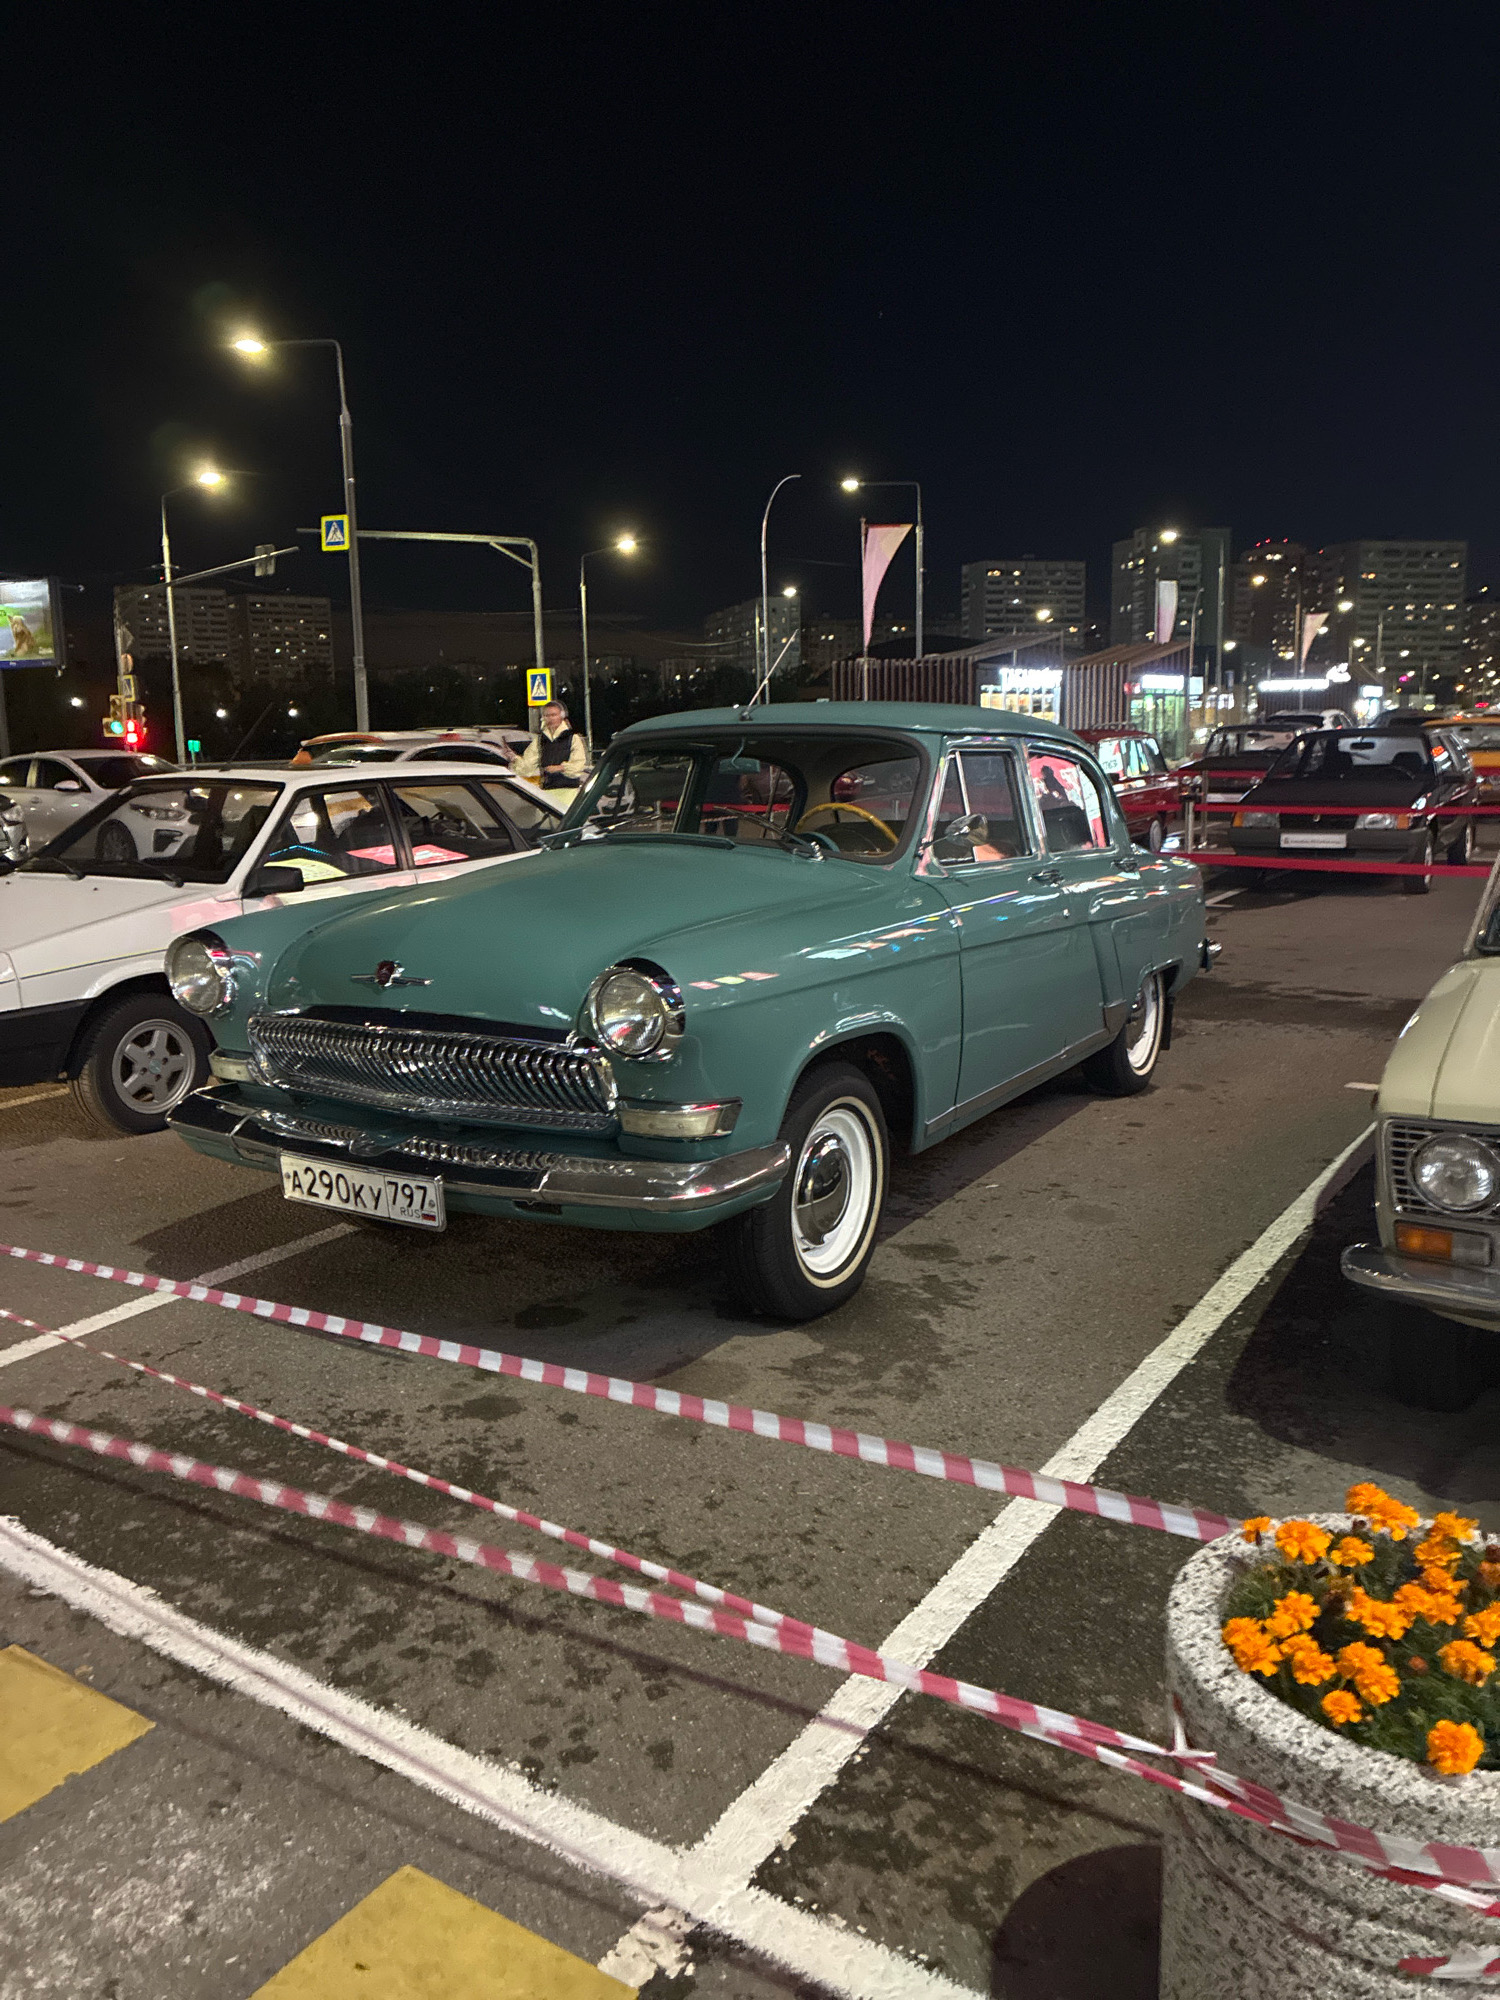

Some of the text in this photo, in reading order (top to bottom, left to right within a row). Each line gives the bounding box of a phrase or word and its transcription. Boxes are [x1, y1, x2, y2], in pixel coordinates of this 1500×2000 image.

[292, 1167, 427, 1210] А290КУ 797
[400, 1206, 422, 1219] RUS
